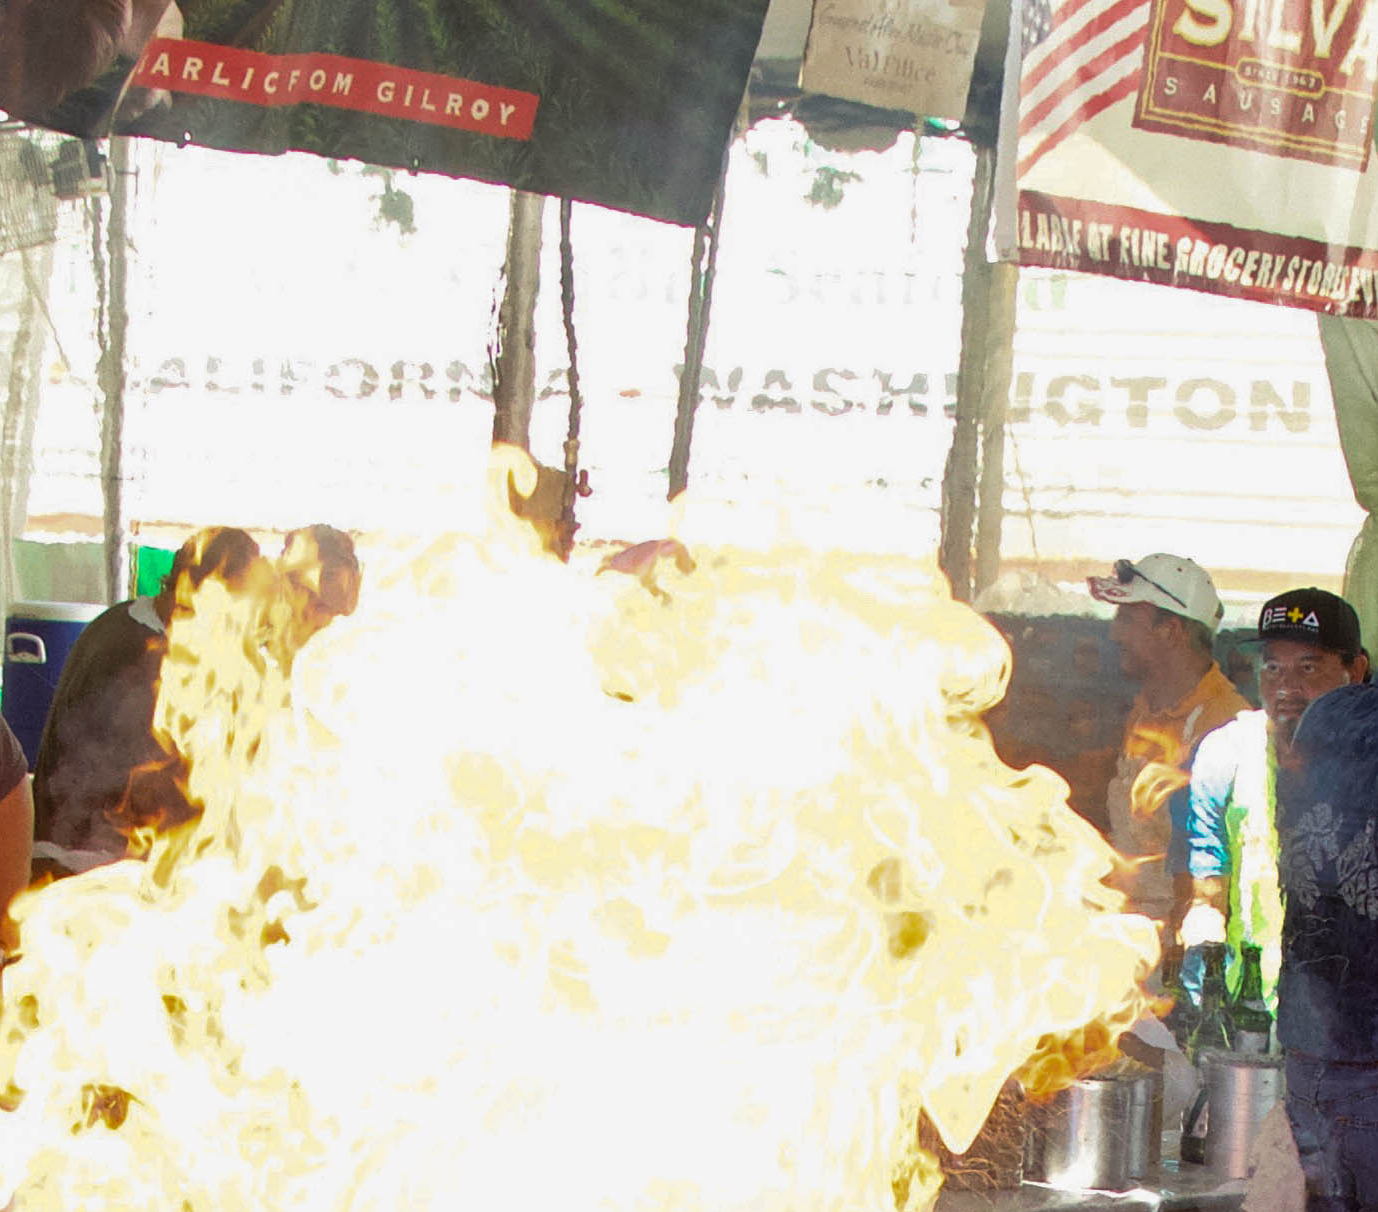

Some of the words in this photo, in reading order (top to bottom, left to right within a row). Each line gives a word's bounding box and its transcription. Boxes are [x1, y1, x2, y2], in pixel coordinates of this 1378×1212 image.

[139, 52, 278, 95] ARLIC
[377, 81, 516, 126] GILROY
[1120, 226, 1172, 270] FINE
[1175, 235, 1286, 290] GROCERY
